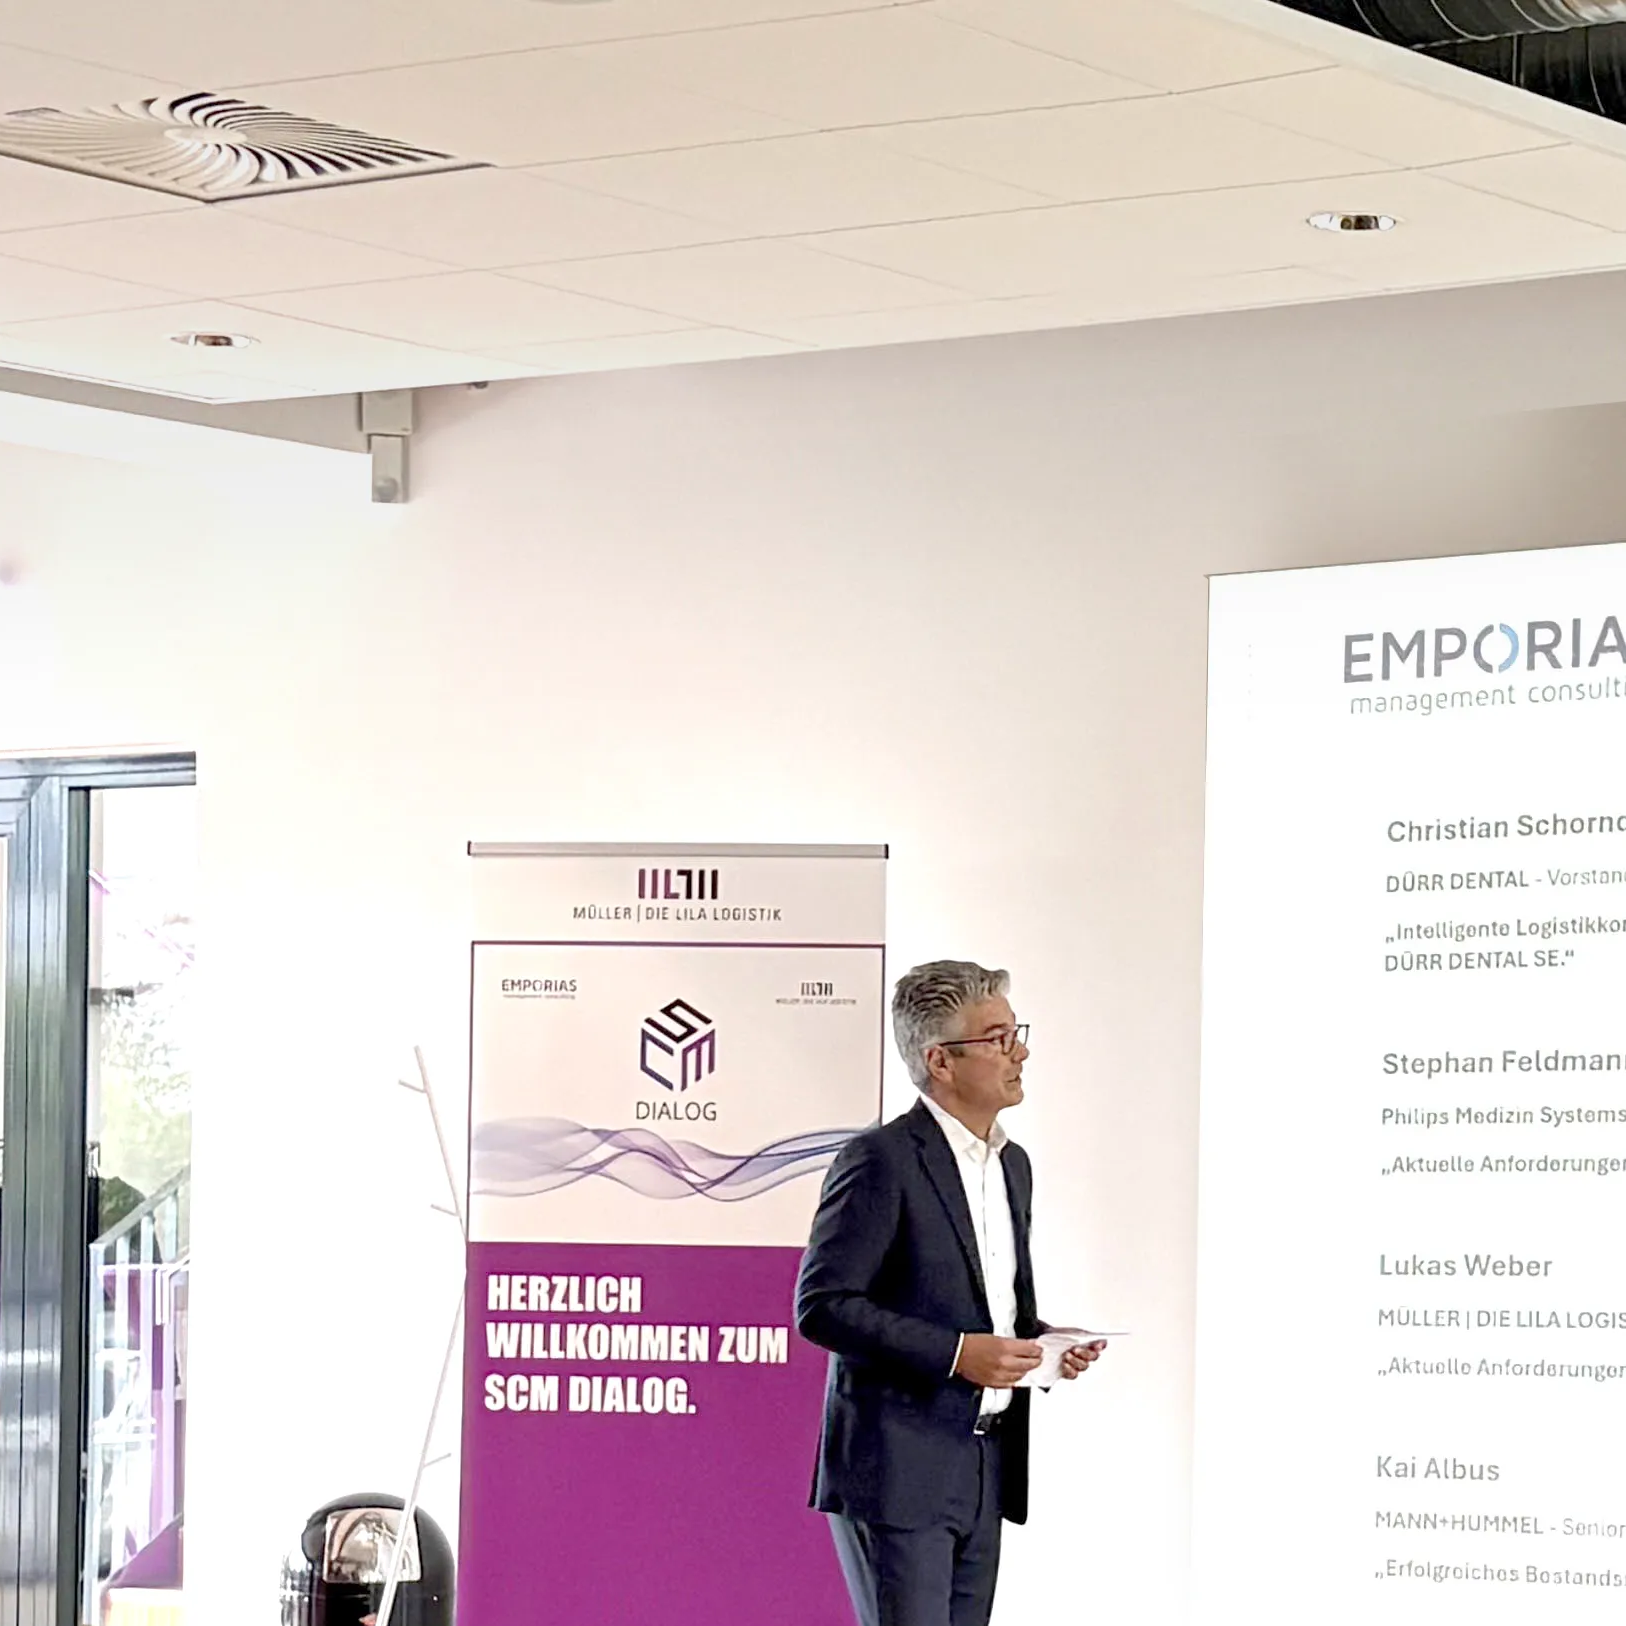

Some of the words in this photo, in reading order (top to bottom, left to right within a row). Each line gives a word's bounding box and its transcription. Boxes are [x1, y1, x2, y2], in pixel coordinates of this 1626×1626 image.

[1350, 684, 1516, 716] management
[1387, 817, 1509, 843] Christian
[1385, 871, 1445, 893] DÜRR
[1450, 869, 1529, 891] DENTAL
[1547, 868, 1626, 886] Vorstan
[573, 904, 632, 920] MÜLLER
[645, 906, 669, 920] DIE
[675, 906, 707, 921] LILA
[713, 906, 782, 921] LOGISTIK
[1384, 951, 1443, 972] DÜRR
[1448, 949, 1529, 970] DENTAL
[501, 978, 578, 992] EMPORIAS
[1382, 1051, 1494, 1079] Stephan
[635, 1101, 717, 1121] DIALOG
[1381, 1107, 1449, 1128] Philips
[1455, 1106, 1534, 1125] Medizin
[1379, 1254, 1457, 1277] Lukas
[1464, 1254, 1553, 1277] Weber
[487, 1274, 642, 1313] HERZLICH
[1378, 1306, 1460, 1327] MÜLLER
[1476, 1310, 1511, 1328] DIE
[1516, 1310, 1562, 1328] LILA
[485, 1323, 709, 1362] WILLKOMMEN
[718, 1326, 788, 1365] ZUM
[484, 1374, 559, 1412] SCM
[567, 1376, 697, 1415] DIALOG.
[1376, 1455, 1417, 1479] Kai
[1424, 1457, 1500, 1482] Albus
[1375, 1511, 1544, 1535] MANN+HUMMEL
[1525, 1565, 1626, 1588] Bestands
